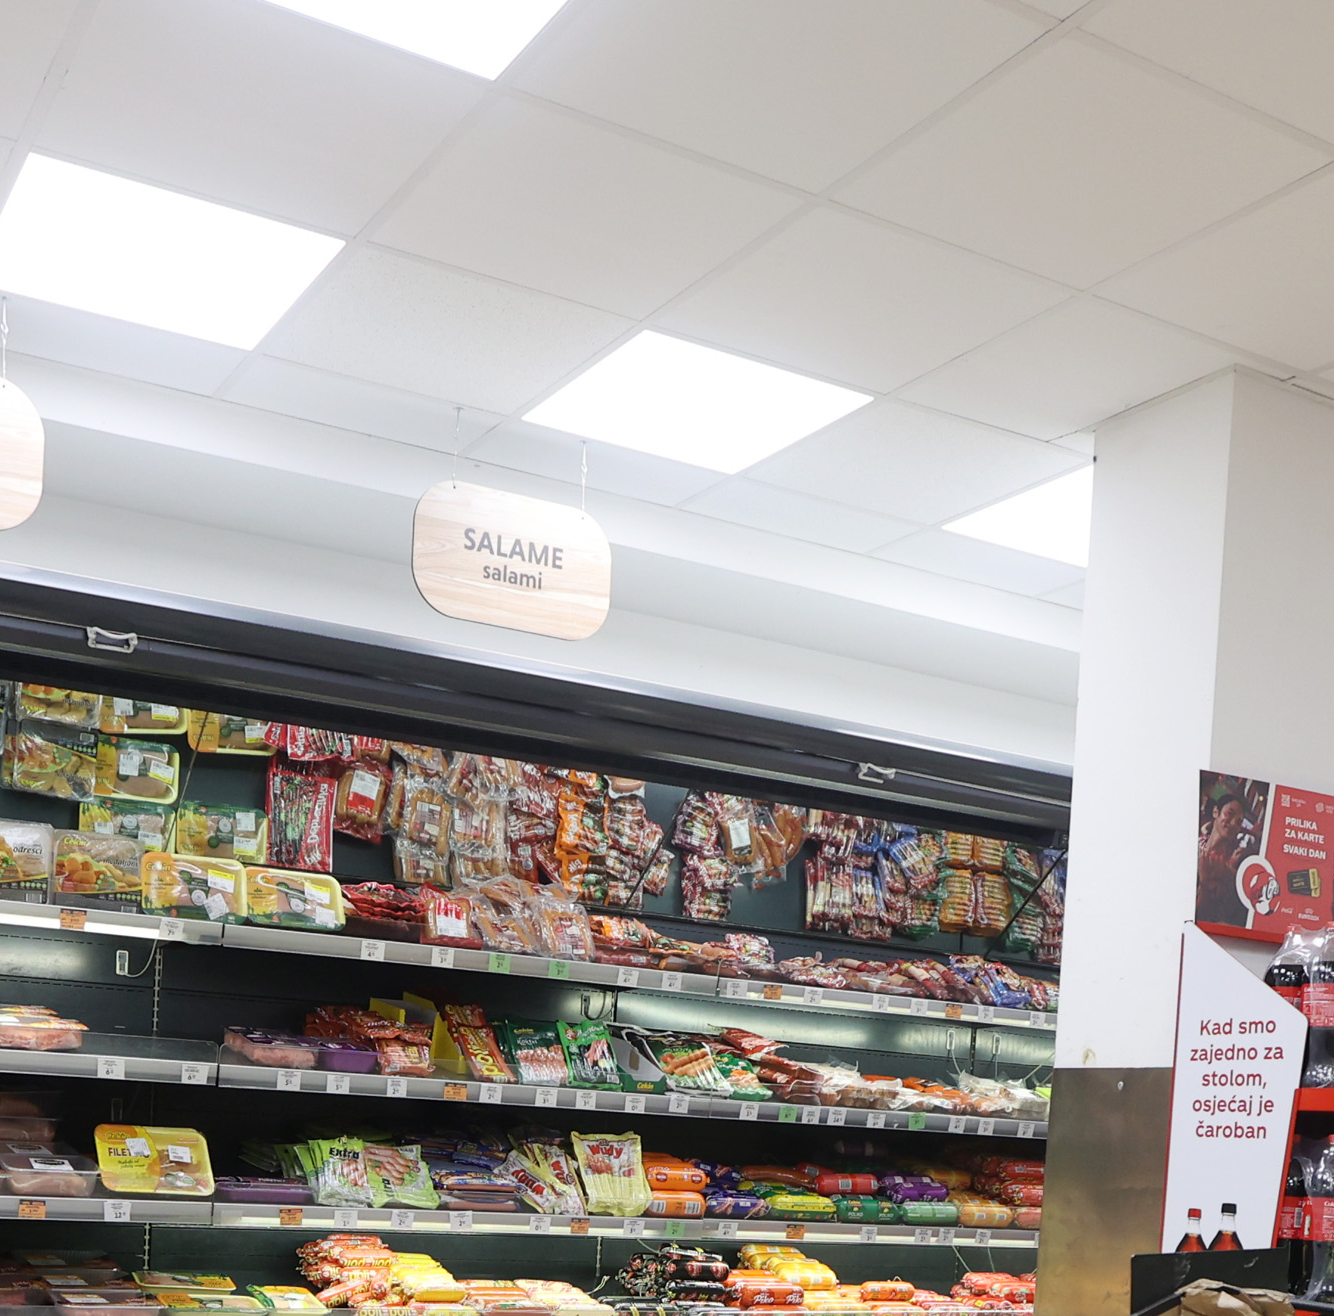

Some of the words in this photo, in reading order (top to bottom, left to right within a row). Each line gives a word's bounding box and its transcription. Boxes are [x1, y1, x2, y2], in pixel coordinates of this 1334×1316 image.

[464, 527, 564, 570] SALAME
[483, 564, 542, 590] salami
[1285, 816, 1318, 831] PRILIKA
[1285, 828, 1296, 839] ZA
[1297, 830, 1325, 844] KARTE
[1283, 844, 1308, 857] SVAKI
[1308, 848, 1326, 860] DAN
[1200, 1018, 1233, 1036] Kad
[1238, 1020, 1277, 1034] smo
[1190, 1043, 1258, 1065] zajedno
[1263, 1046, 1284, 1060] za
[636, 1081, 655, 1090] Cekin
[1201, 1069, 1267, 1089] stolom,
[1192, 1094, 1253, 1116] osjećaj
[1257, 1095, 1275, 1117] je
[1195, 1120, 1267, 1139] čaroban
[328, 1146, 360, 1160] Extra
[587, 1143, 624, 1159] Wudy
[753, 1294, 775, 1304] Piko
